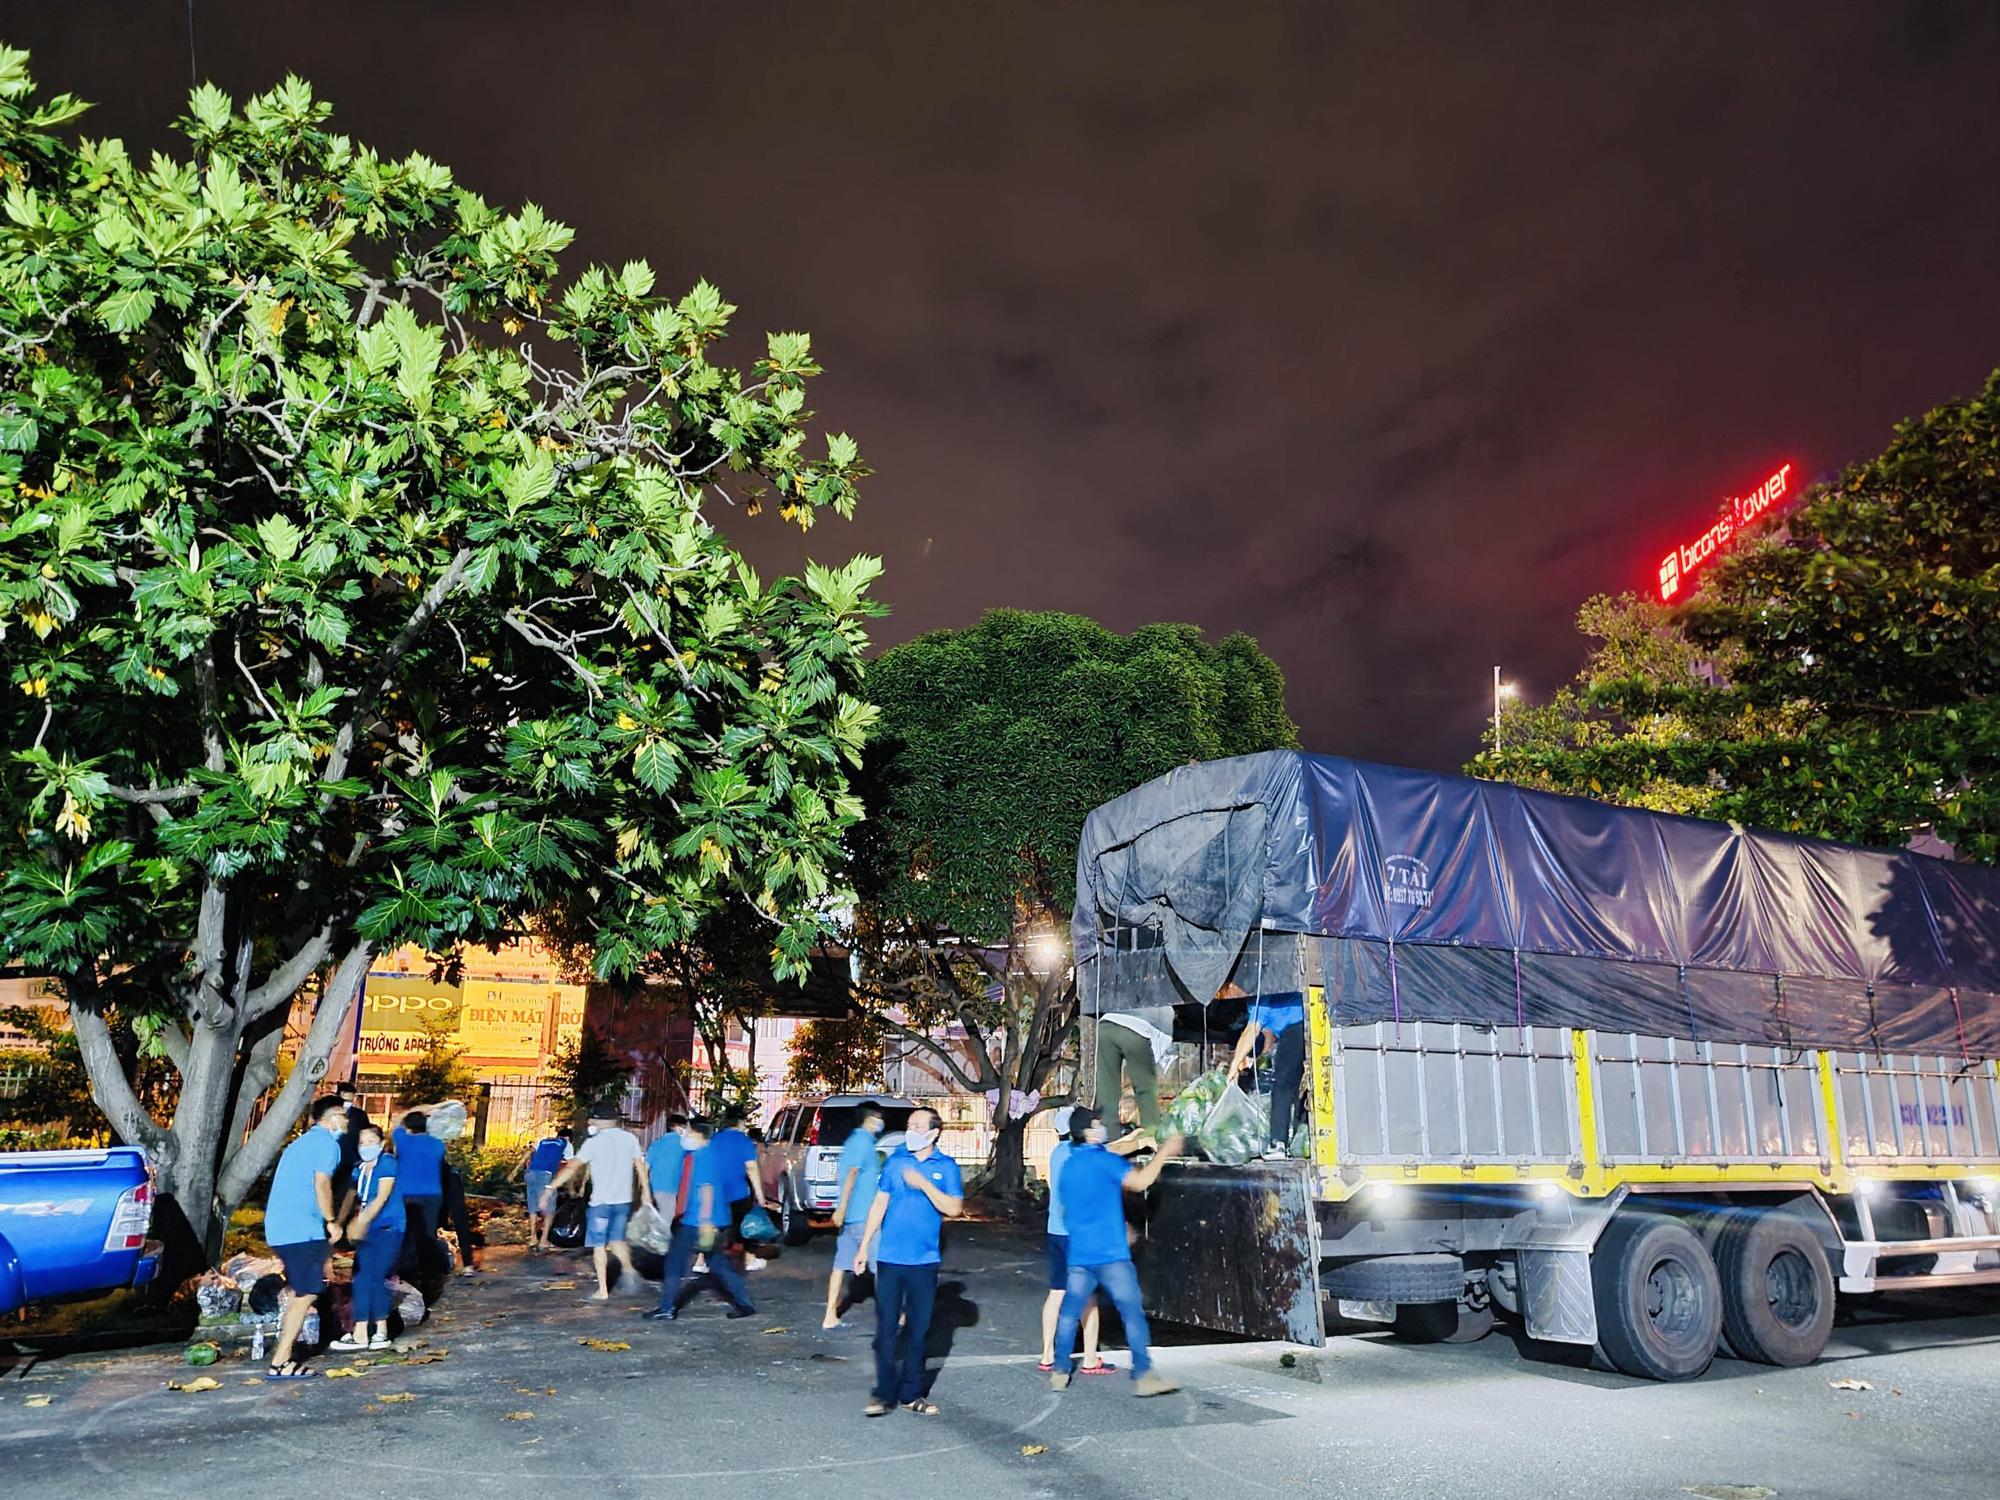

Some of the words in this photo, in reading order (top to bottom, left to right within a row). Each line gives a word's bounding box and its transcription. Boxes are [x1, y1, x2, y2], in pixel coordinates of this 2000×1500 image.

[1399, 866, 1427, 888] TÀI
[469, 1007, 507, 1026] ĐIỆN
[511, 1009, 545, 1028] MẶT
